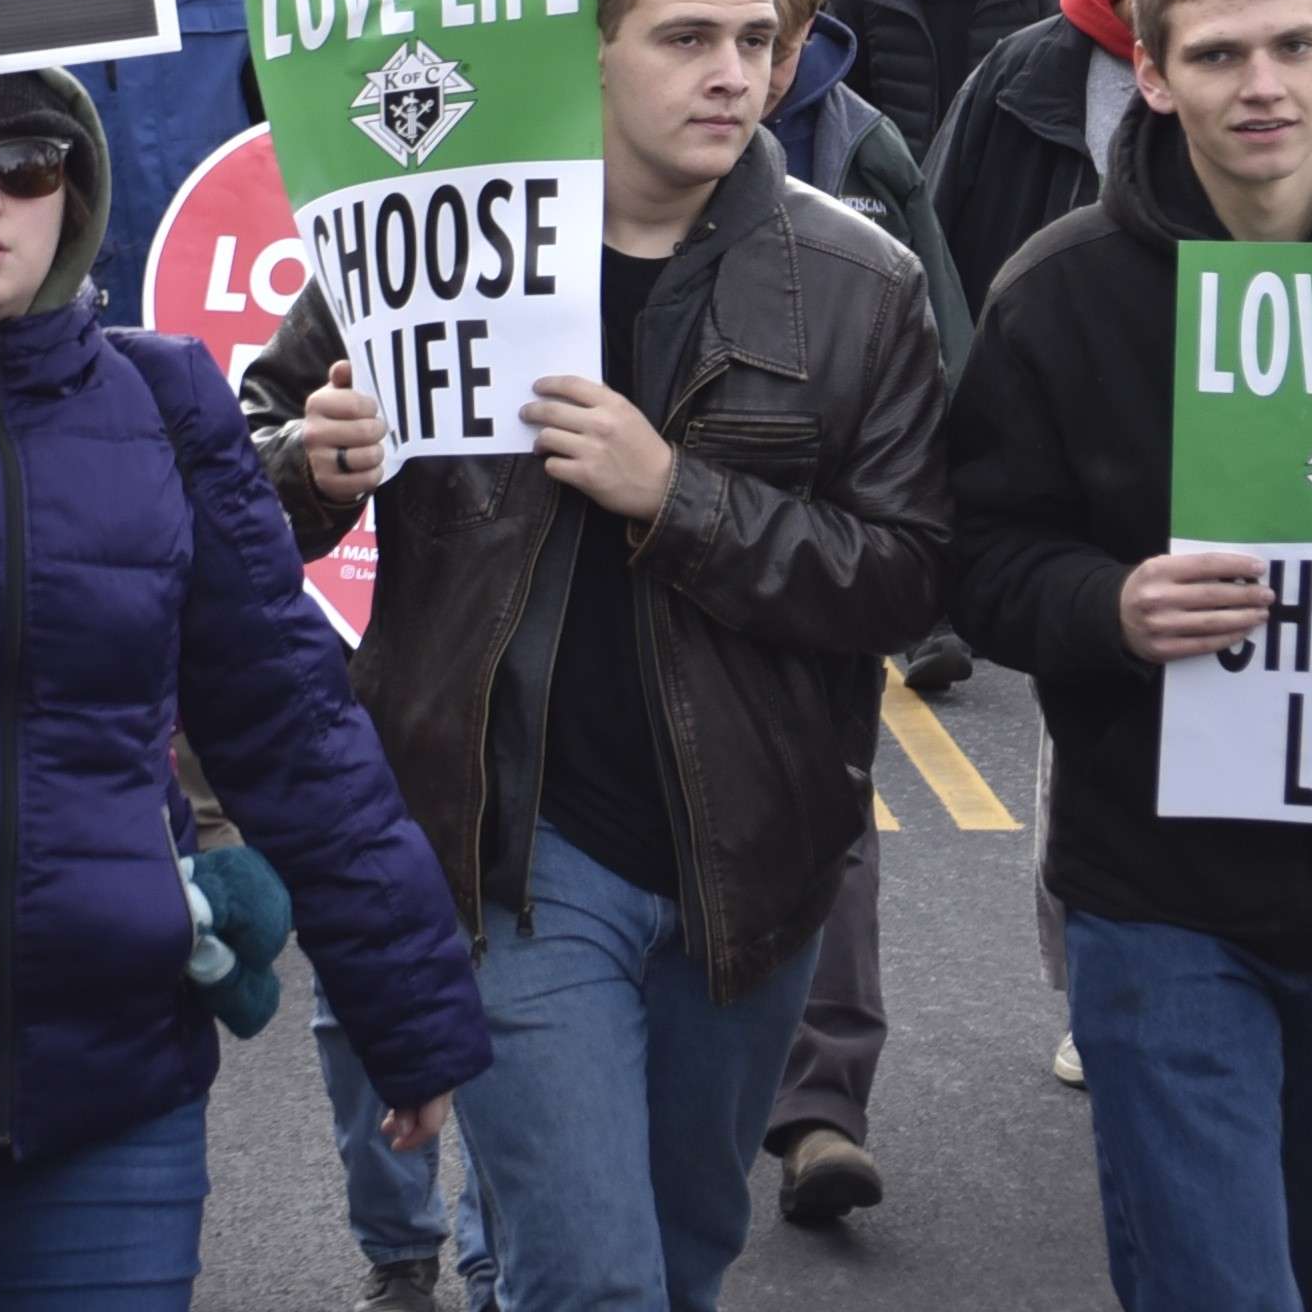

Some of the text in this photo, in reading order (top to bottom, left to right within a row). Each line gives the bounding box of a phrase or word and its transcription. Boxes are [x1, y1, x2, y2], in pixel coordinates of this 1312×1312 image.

[384, 71, 398, 90] K
[425, 66, 441, 86] C
[313, 177, 559, 328] CHOOSE
[364, 319, 493, 451] LIFE
